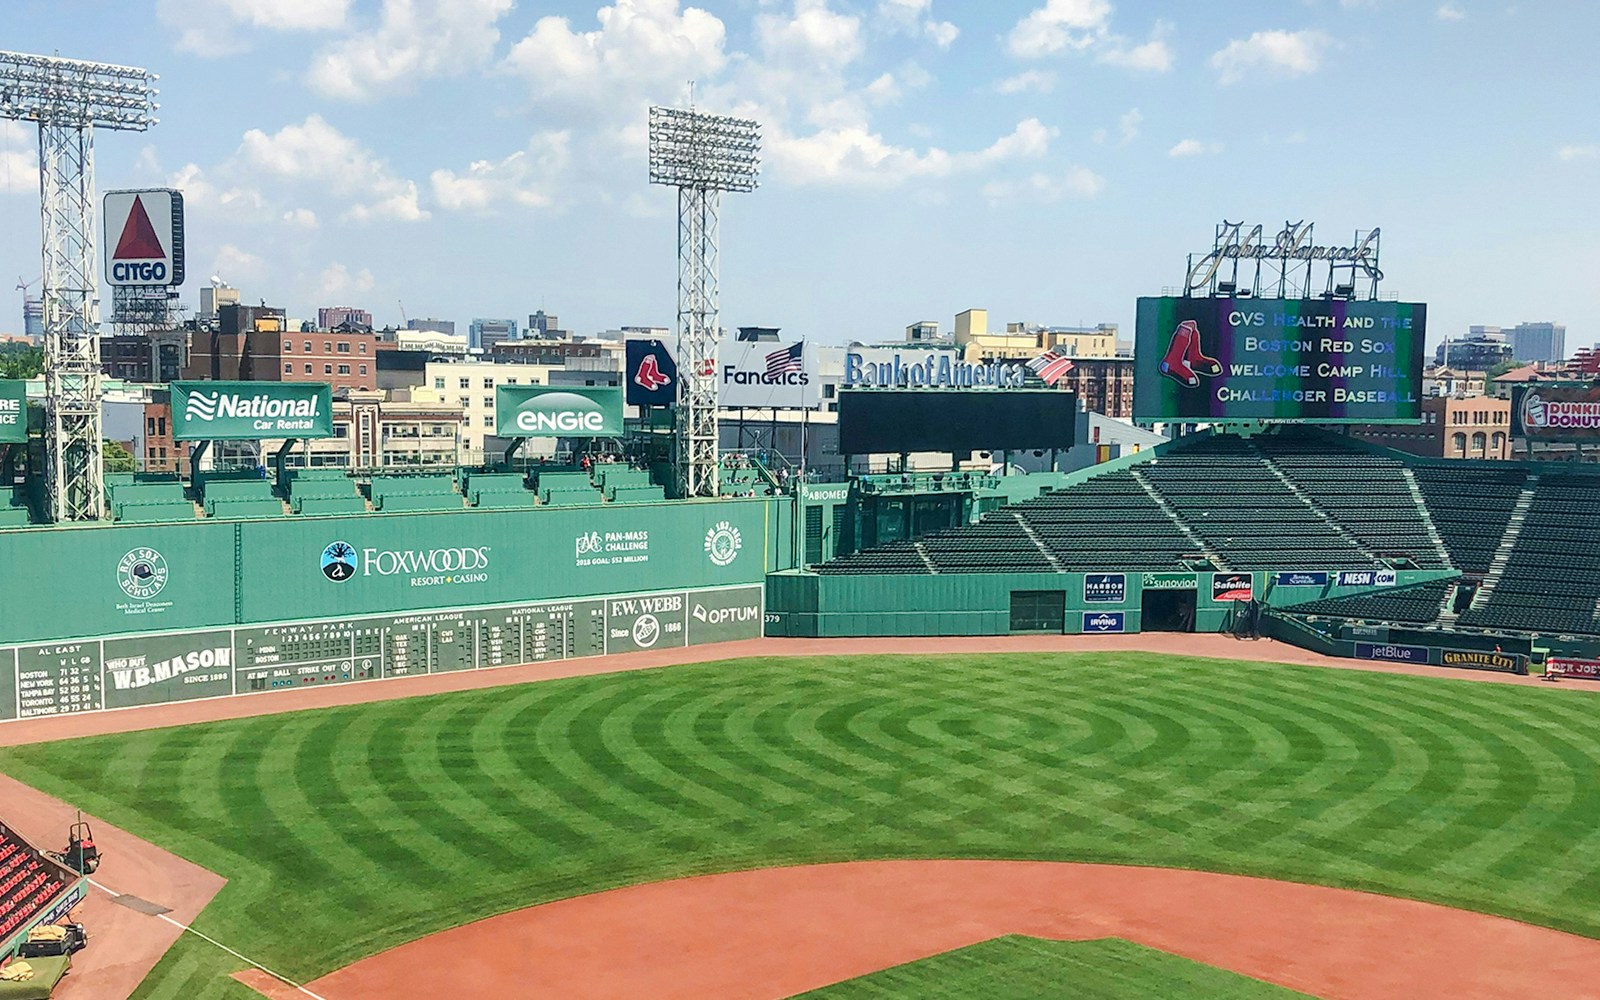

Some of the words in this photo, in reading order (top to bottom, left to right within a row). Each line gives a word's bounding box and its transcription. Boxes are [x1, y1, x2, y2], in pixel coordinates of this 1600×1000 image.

[1188, 219, 1267, 289] John
[1268, 219, 1384, 281] Hancock
[113, 262, 166, 281] CITGO
[1228, 312, 1265, 327] CVS
[844, 352, 909, 385] Bank
[913, 354, 934, 385] of
[936, 354, 1026, 388] America
[1550, 404, 1600, 415] DUNKI
[253, 420, 274, 430] Car
[276, 419, 314, 430] Rental
[808, 490, 848, 501] ABIOMED
[605, 531, 648, 542] PAN-MASS
[605, 541, 648, 552] CHALLENGE
[120, 553, 136, 573] RED
[138, 549, 159, 563] SOX
[363, 547, 489, 576] FOXWOODS
[624, 554, 649, 563] MILLION
[122, 567, 166, 597] SCHOLARS
[411, 575, 445, 587] RESORT
[453, 573, 488, 583] CASINO
[1153, 578, 1198, 588] sunovion
[1343, 572, 1371, 584] NESN
[1214, 581, 1251, 589] Safelite
[639, 596, 682, 613] WEBB
[512, 607, 545, 615] NATIONAL
[708, 606, 758, 624] OPTUM
[393, 615, 432, 624] AMERICAN
[435, 613, 463, 621] LEAGUE
[765, 615, 780, 623] 379
[1090, 618, 1117, 626] IRVING
[264, 626, 314, 636] FENWAY
[322, 622, 354, 631] PARK
[611, 628, 630, 638] Since
[55, 645, 81, 655] EAST
[1371, 645, 1411, 659] jetBlue
[106, 659, 127, 670] WHO
[128, 658, 146, 668] BUT
[1444, 652, 1491, 664] GRANITE
[20, 671, 48, 680] BOSTON
[60, 668, 68, 676] 71
[273, 669, 291, 677] BALL
[297, 666, 320, 674] STRIKE
[322, 664, 336, 672] OUT
[20, 680, 36, 688] NEW
[36, 679, 54, 687] YORK
[59, 678, 69, 686] 64
[70, 676, 80, 685] 36
[184, 675, 208, 684] SINCE
[20, 689, 42, 698] TAMPA
[42, 688, 55, 696] BAY
[59, 687, 69, 695] 52
[70, 686, 80, 694] 50
[21, 698, 54, 707] TORONTO
[60, 696, 69, 704] 46
[70, 695, 80, 703] 55
[82, 694, 91, 702] 24
[21, 706, 57, 717] BALTIMORE
[60, 705, 70, 713] 29
